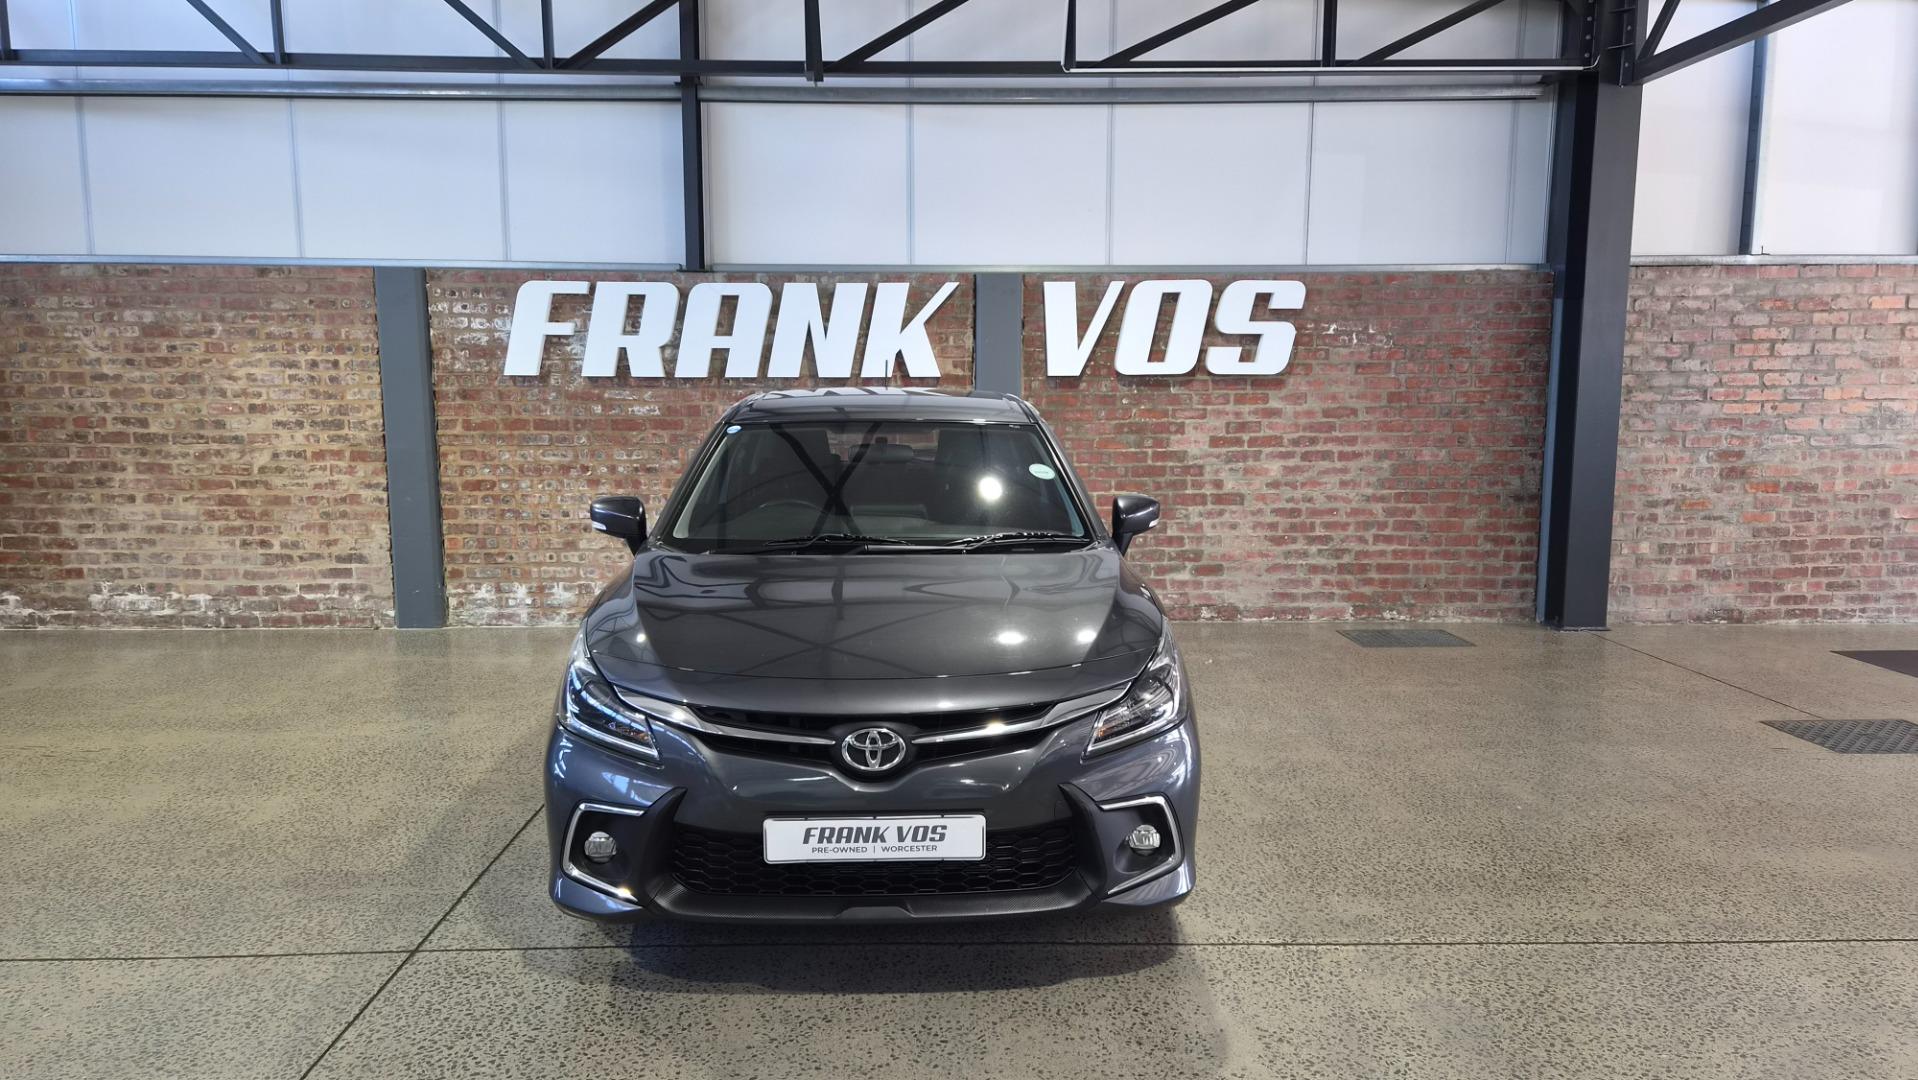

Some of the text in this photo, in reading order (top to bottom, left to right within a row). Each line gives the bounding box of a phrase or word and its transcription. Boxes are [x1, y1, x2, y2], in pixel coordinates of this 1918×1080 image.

[503, 279, 1306, 379] FRANK VOS
[803, 825, 947, 844] FRANK VOS
[812, 845, 937, 854] PRE-OWNED WORCESTER
